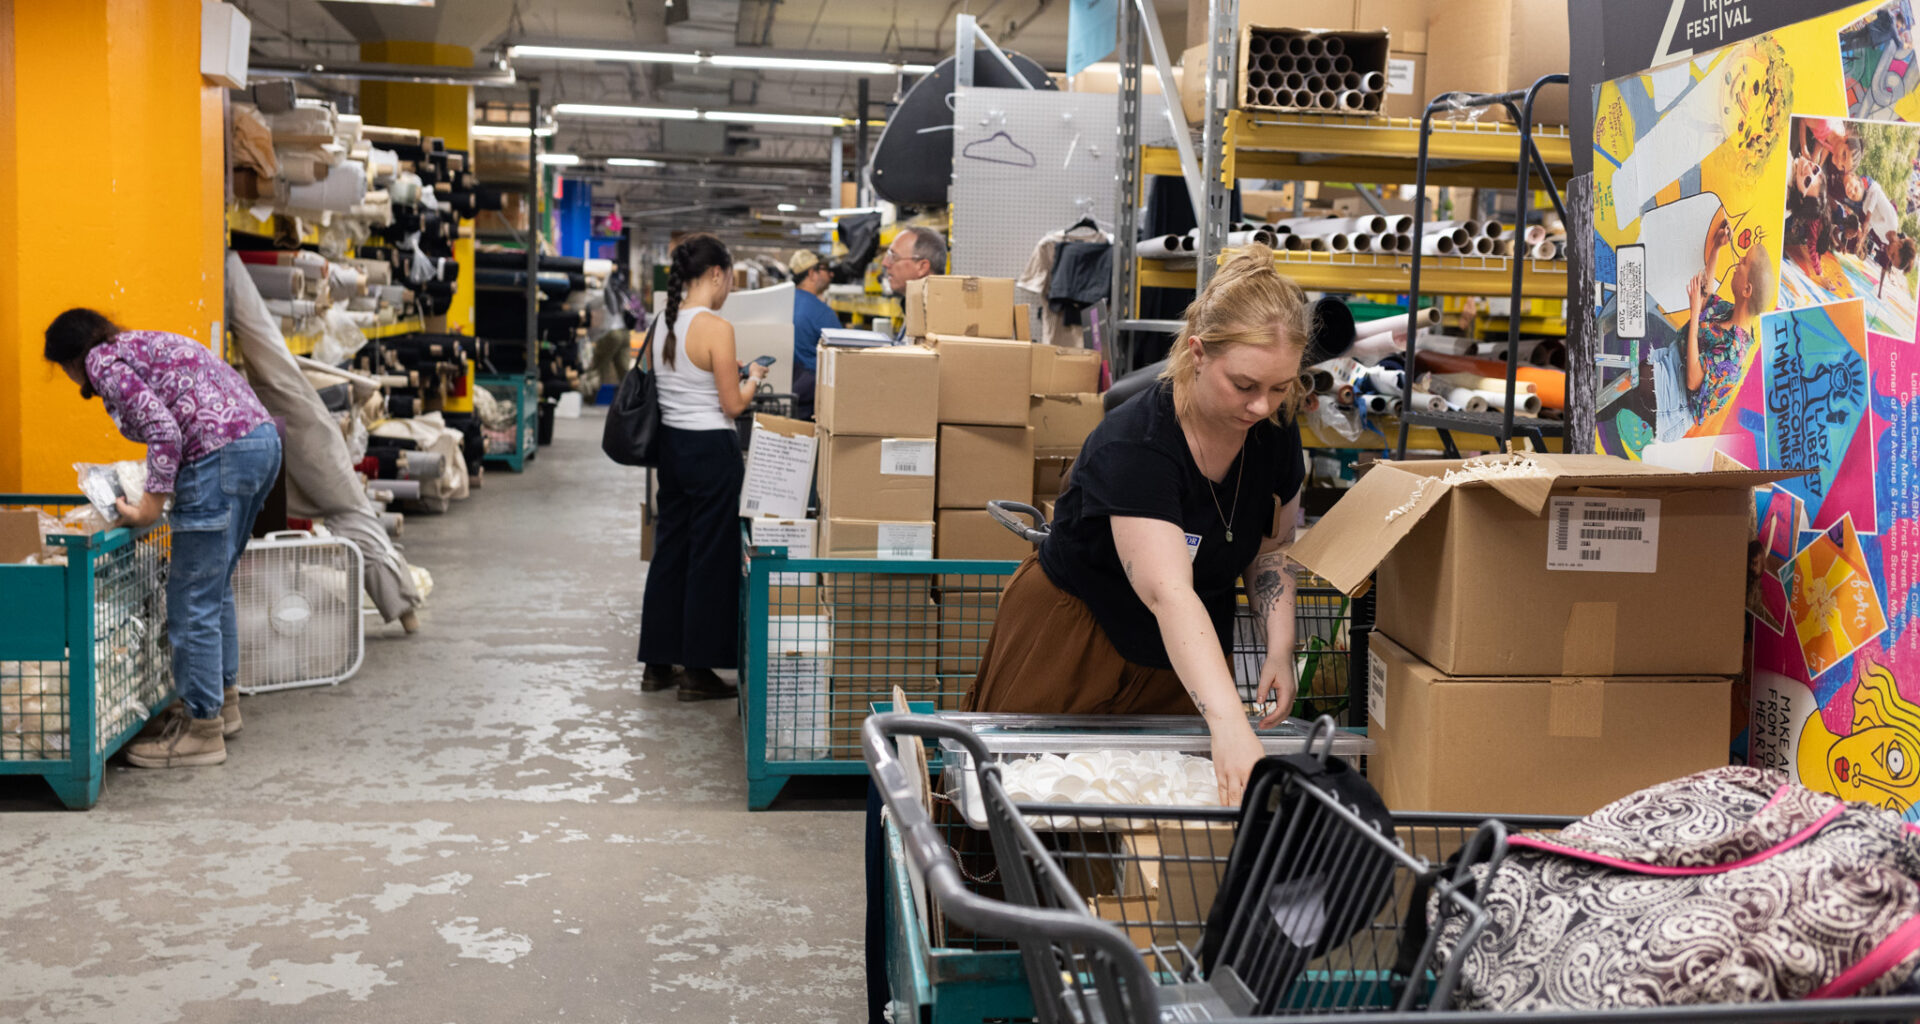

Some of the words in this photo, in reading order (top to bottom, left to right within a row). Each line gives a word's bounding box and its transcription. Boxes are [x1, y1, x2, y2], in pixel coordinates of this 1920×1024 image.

[1890, 398, 1897, 411] of
[1900, 391, 1908, 460] Community
[1805, 414, 1822, 498] LIBERTY
[1815, 406, 1831, 464] LADY
[1911, 426, 1919, 468] Center
[1890, 440, 1898, 484] Avenue
[1891, 487, 1899, 497] &
[1901, 502, 1908, 515] at
[1911, 485, 1919, 536] FABNYC
[1890, 501, 1898, 551] Houston
[1911, 553, 1919, 589] Thrive
[1890, 599, 1899, 664] Manhattan
[1900, 591, 1908, 628] Green
[1911, 593, 1919, 649] Collective
[1755, 700, 1766, 767] HEART
[1767, 688, 1778, 737] FROM
[1779, 695, 1792, 750] MAKE
